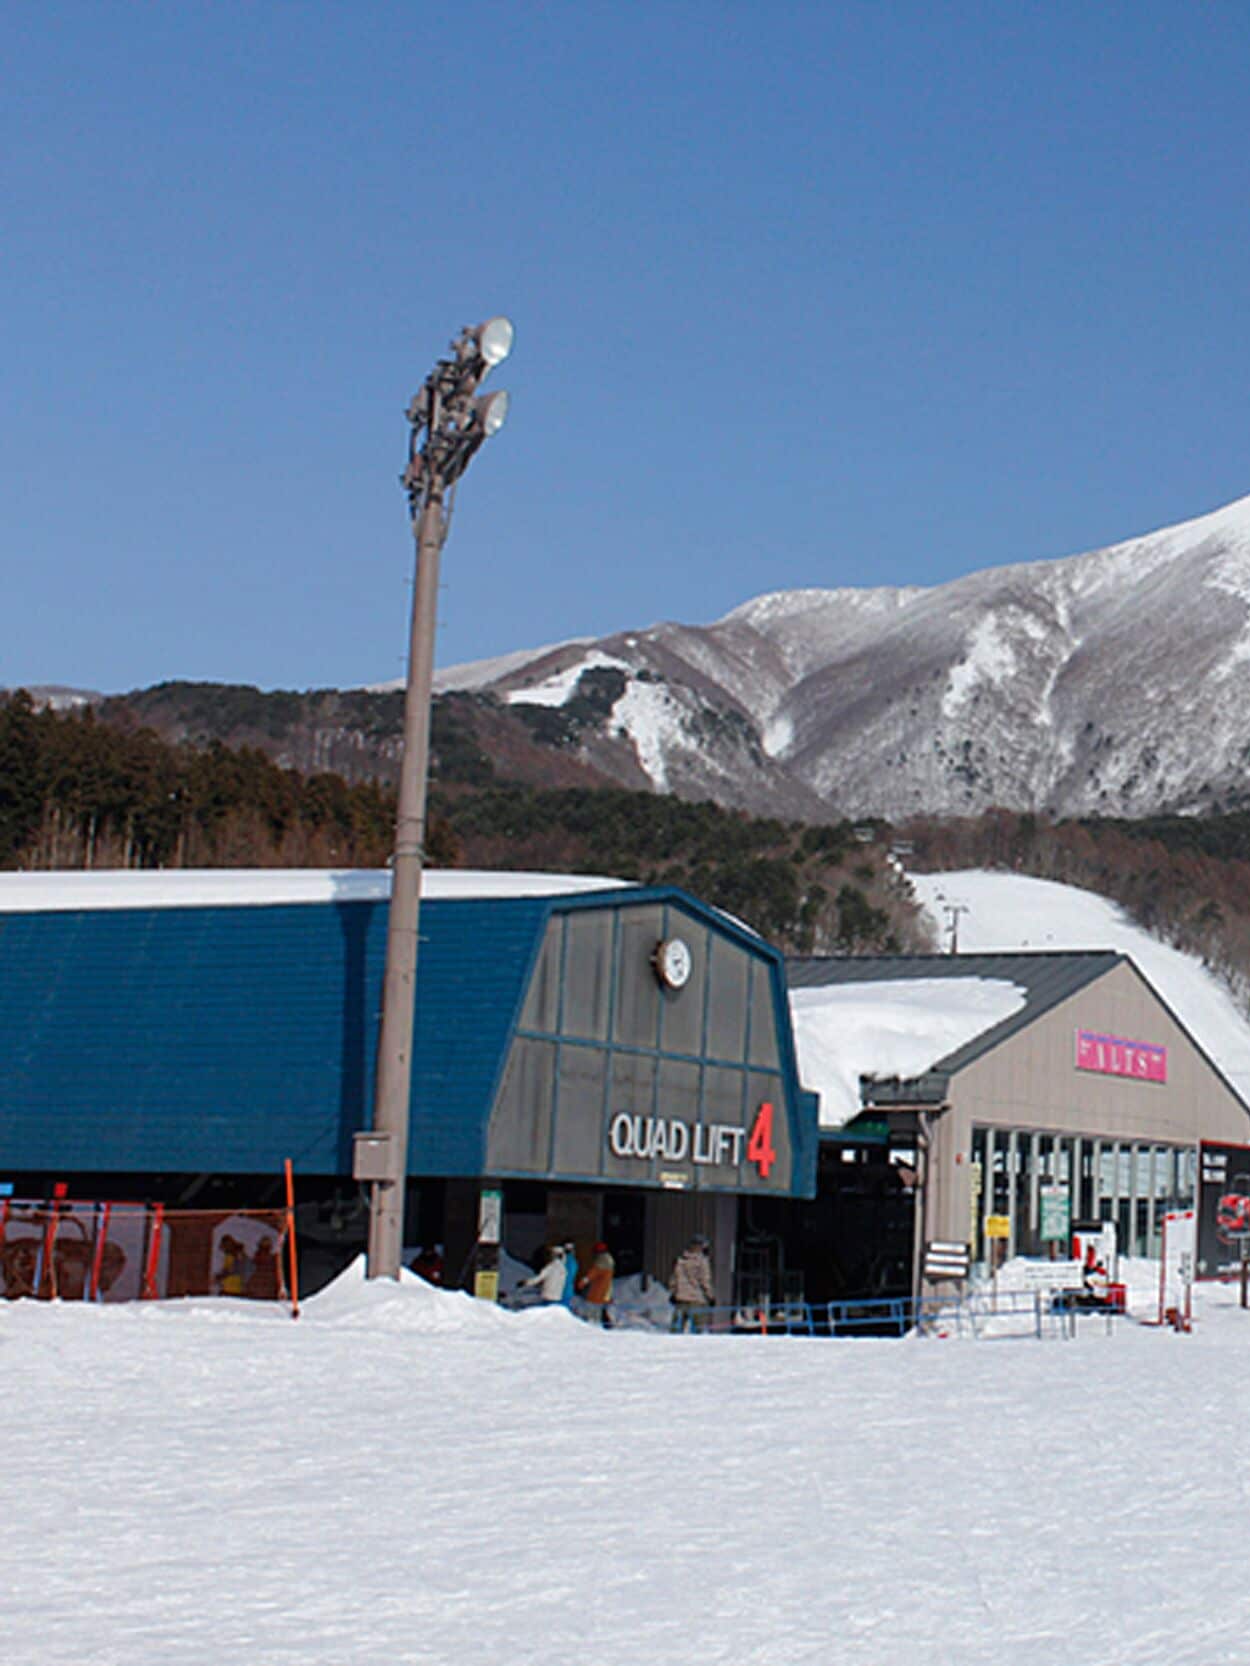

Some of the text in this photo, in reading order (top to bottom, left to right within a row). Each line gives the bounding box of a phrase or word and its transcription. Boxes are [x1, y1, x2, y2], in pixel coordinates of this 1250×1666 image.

[610, 1102, 776, 1178] QUAD LIFT 4
